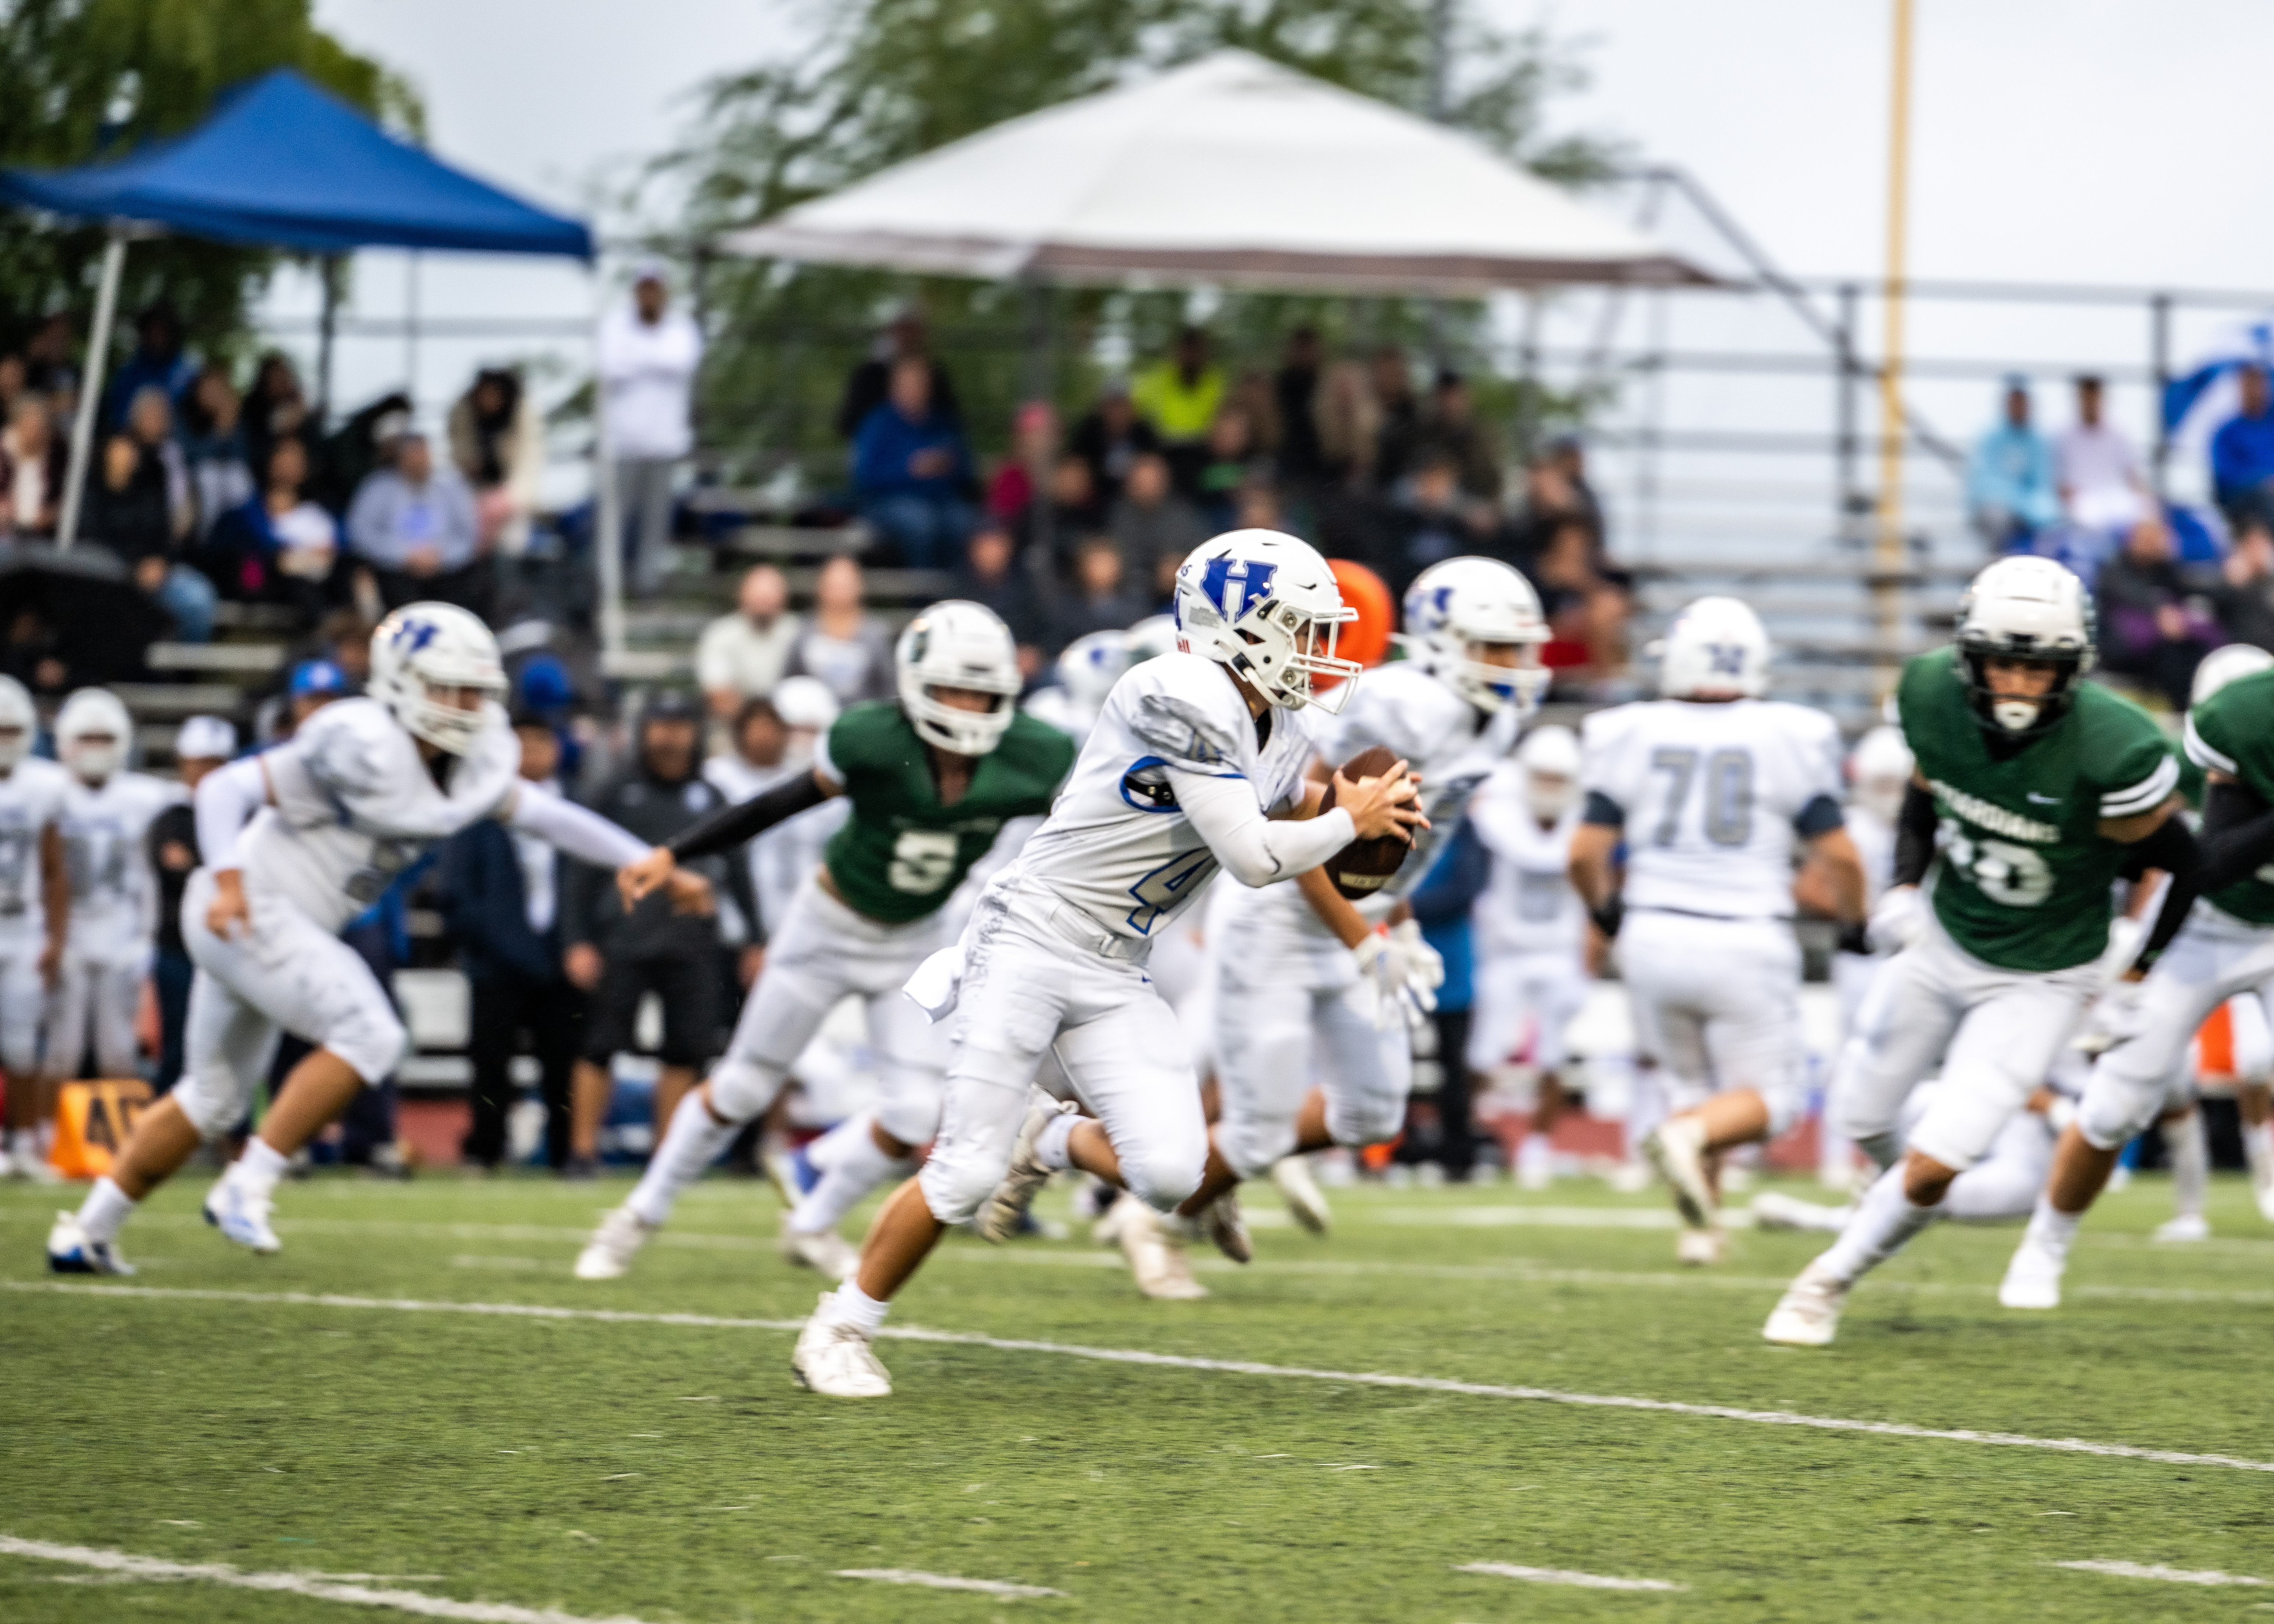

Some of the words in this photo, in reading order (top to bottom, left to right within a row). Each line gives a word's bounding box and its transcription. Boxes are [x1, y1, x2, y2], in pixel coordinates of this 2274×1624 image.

[1200, 557, 1278, 624] H
[1650, 745, 1754, 849] 70
[887, 830, 960, 895] 5
[1126, 845, 1218, 935] 4
